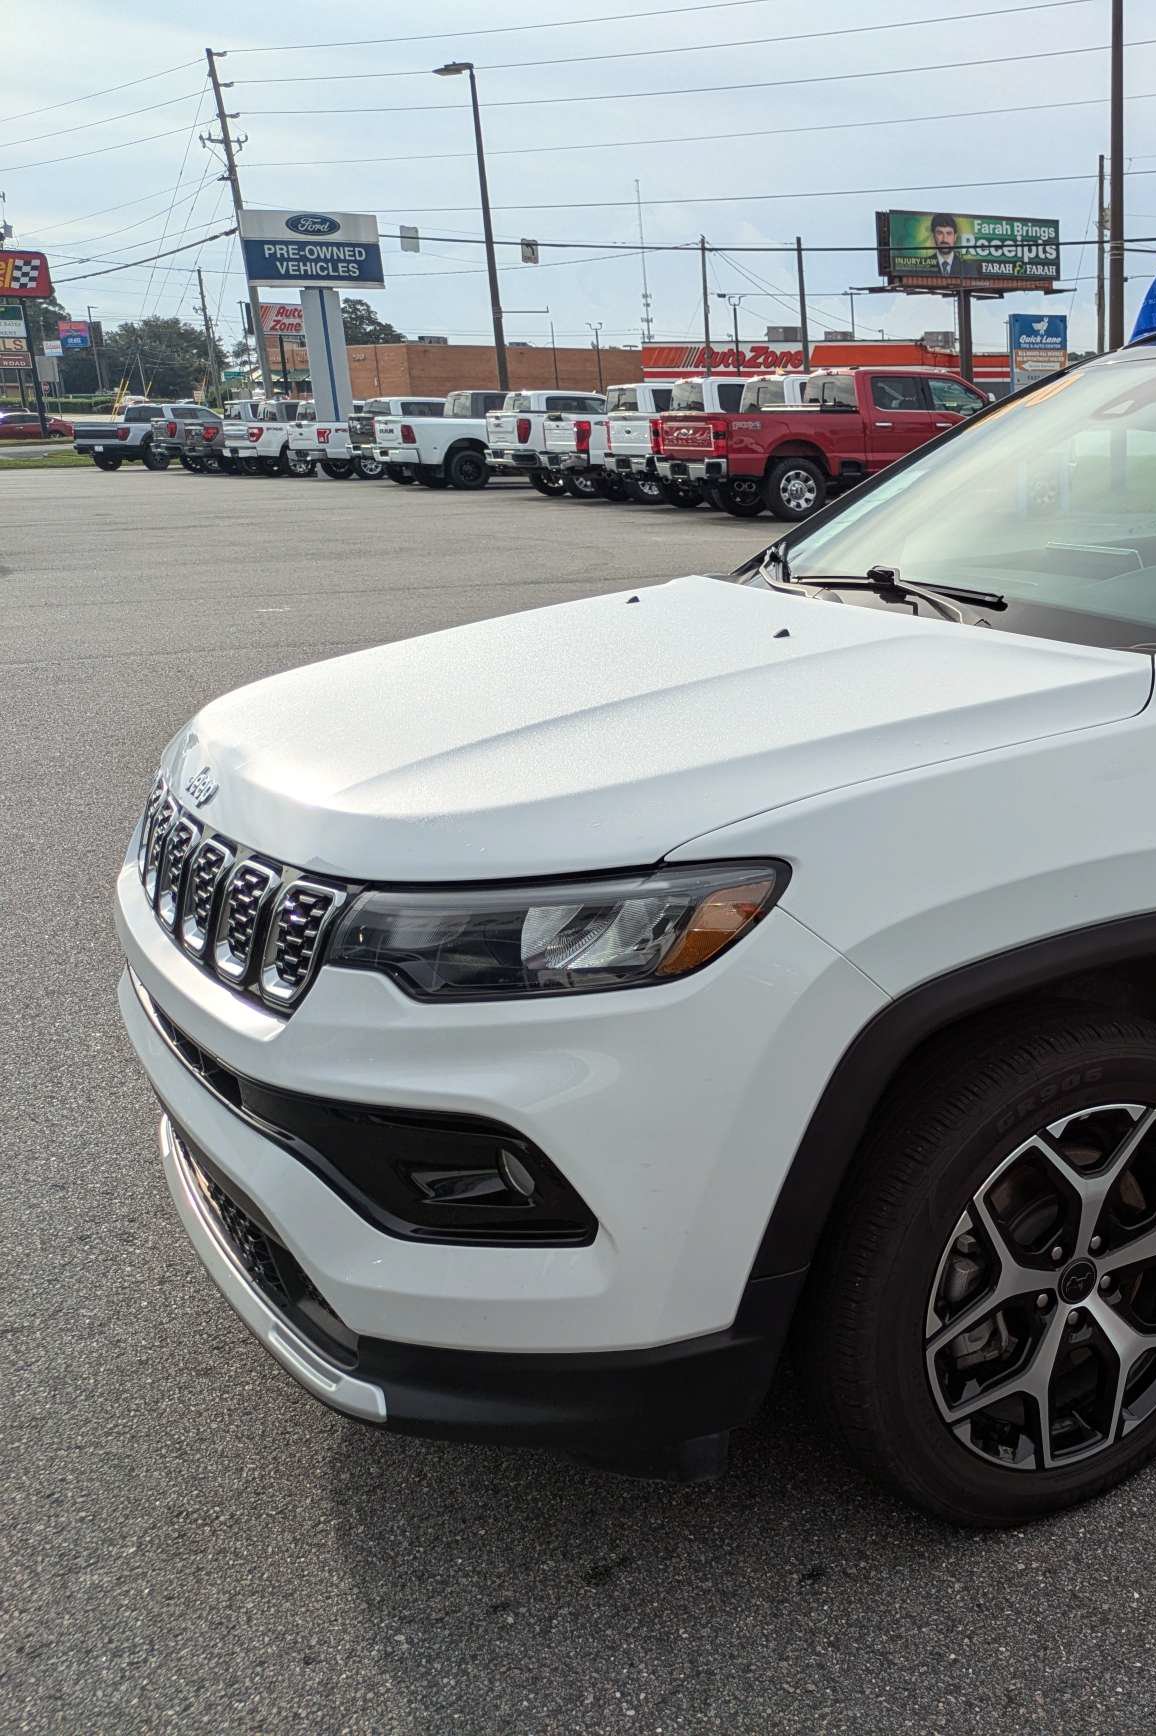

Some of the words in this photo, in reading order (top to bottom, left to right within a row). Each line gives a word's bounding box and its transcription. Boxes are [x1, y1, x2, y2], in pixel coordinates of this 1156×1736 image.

[298, 218, 330, 231] Ford
[974, 220, 1011, 235] Farah
[1014, 222, 1055, 240] Brings
[263, 244, 366, 260] PRE-OWNED
[961, 234, 1057, 262] Receipts
[276, 261, 360, 276] VEHICLES
[895, 257, 921, 265] INJURY
[982, 262, 1013, 274] FARAH
[1026, 265, 1056, 275] FARAH
[271, 319, 303, 331] Zone
[1019, 334, 1041, 343] Quick
[1042, 335, 1061, 343] Lane
[694, 346, 804, 368] AutoZone
[185, 766, 220, 808] Jeep
